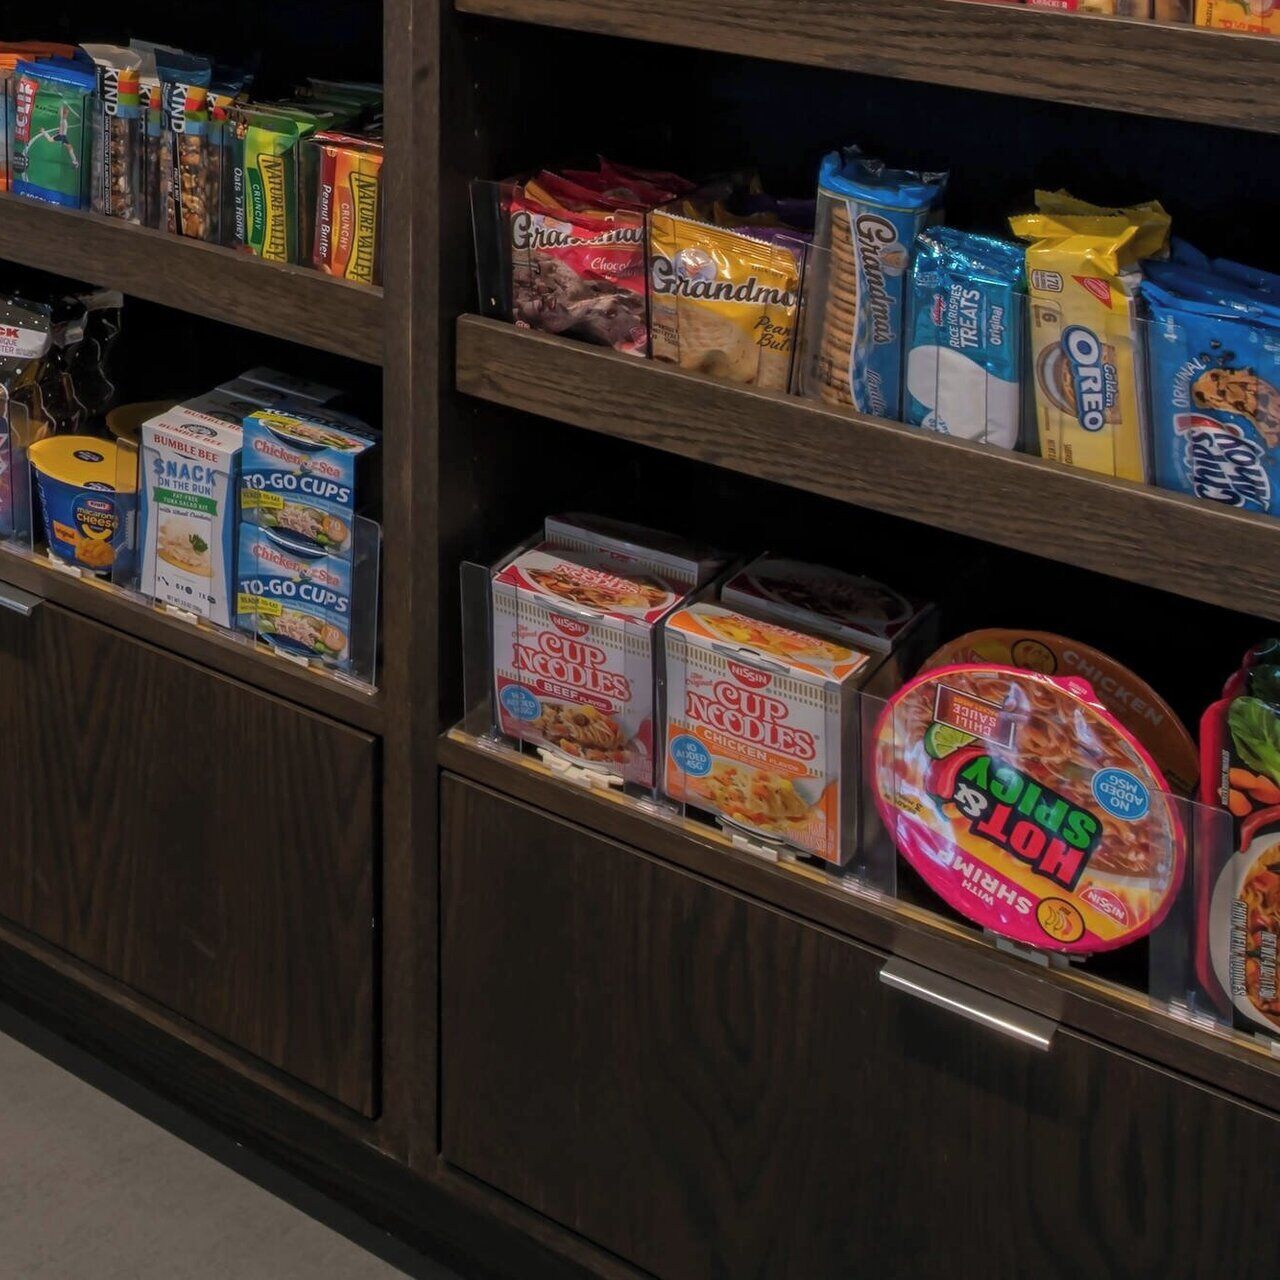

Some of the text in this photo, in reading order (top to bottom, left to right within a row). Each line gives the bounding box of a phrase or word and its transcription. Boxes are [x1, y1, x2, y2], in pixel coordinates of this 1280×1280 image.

[104, 67, 118, 116] KIND
[171, 82, 188, 133] KIND
[234, 167, 244, 241] Oats Honey
[252, 184, 263, 230] CRUNCHY
[262, 158, 287, 261] NATURE VALLEY
[319, 184, 332, 258] Peanut Butter
[340, 202, 350, 250] CRUNCHY
[356, 176, 378, 233] NATURE
[856, 213, 899, 345] Grandma's
[1049, 271, 1061, 291] 170
[949, 283, 963, 349] RICE KRISPIES
[959, 289, 981, 348] TREATS
[1066, 328, 1104, 431] OREO
[1101, 362, 1116, 407] Golden
[1172, 357, 1207, 408] ORIGINAL
[152, 459, 216, 485] SNACK
[154, 434, 219, 463] BUMBLE BEE
[159, 477, 212, 495] ON THE RUN
[243, 473, 350, 504] TO-GO CUPS
[241, 578, 349, 612] TO-GO CUPS
[512, 644, 632, 703] NOODLES
[539, 632, 607, 670] CUP
[544, 680, 608, 710] BEEF FLAVOR
[716, 680, 789, 721] CUP
[1062, 649, 1164, 727] CHICKEN
[686, 691, 817, 761] NOODLES
[702, 729, 768, 763] CHICKEN
[961, 755, 1098, 851] SPICY
[1100, 783, 1144, 807] ADDED
[1108, 775, 1138, 793] MSG
[1109, 796, 1129, 813] NO
[953, 783, 1087, 887] HOT &
[934, 847, 1033, 916] SHRIMP
[960, 878, 995, 907] WITH
